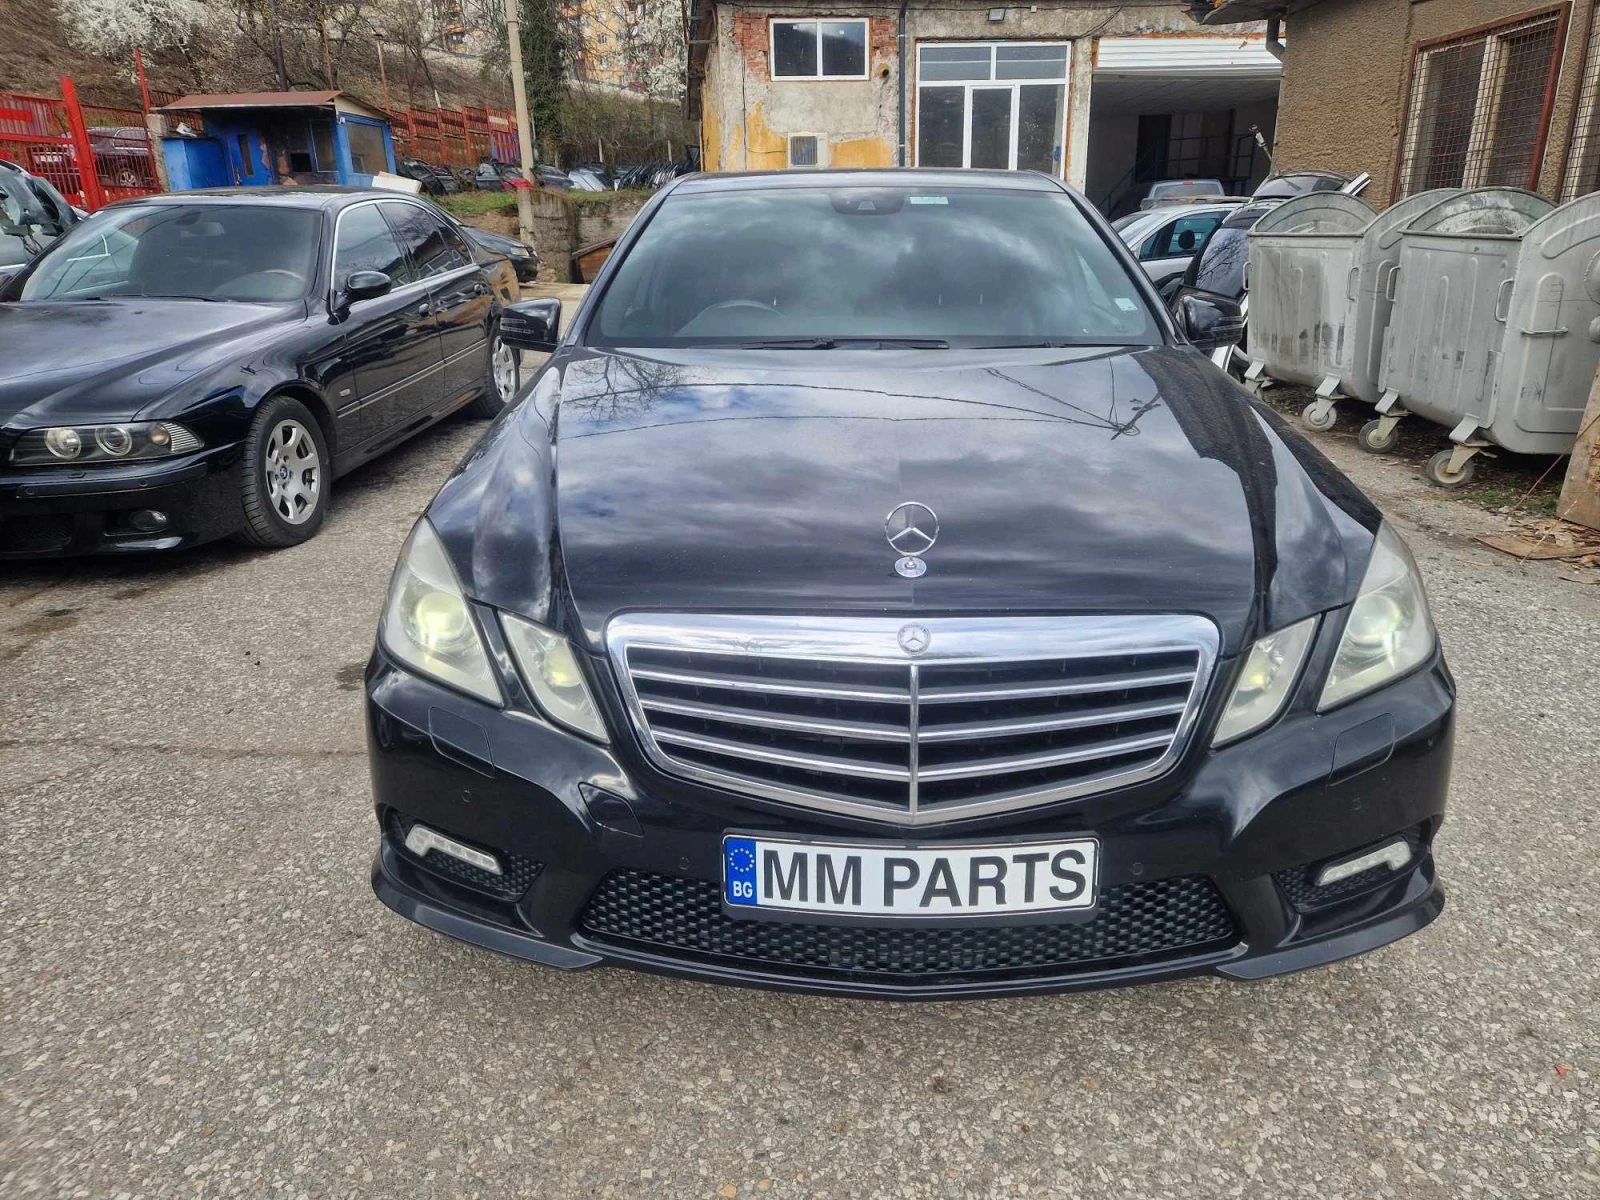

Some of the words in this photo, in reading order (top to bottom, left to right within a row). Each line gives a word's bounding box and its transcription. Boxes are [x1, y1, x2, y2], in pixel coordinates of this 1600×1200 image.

[733, 880, 753, 898] BG
[763, 849, 862, 906] MM
[883, 849, 1086, 908] PARTS
